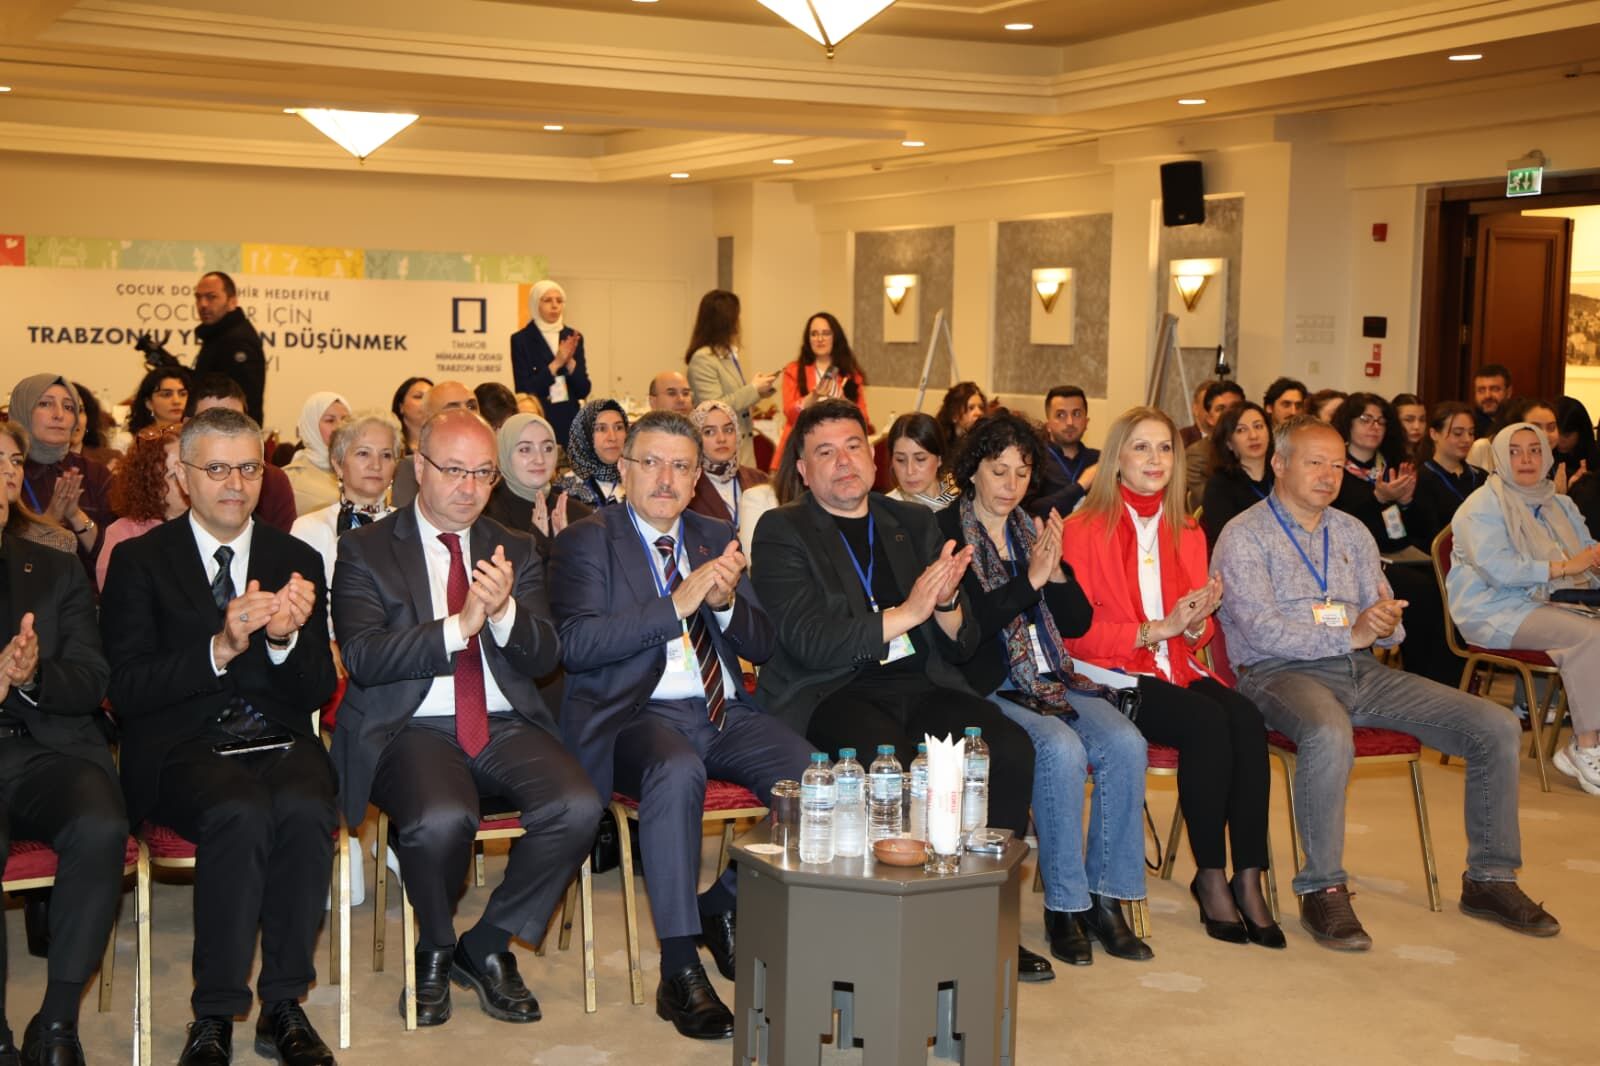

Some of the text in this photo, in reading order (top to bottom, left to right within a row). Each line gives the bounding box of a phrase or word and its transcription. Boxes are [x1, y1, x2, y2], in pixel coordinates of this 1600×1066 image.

[116, 283, 165, 297] ÇOCUK
[237, 287, 259, 299] HİR
[265, 288, 330, 302] HEDEFİYLE
[267, 303, 312, 326] İÇİN
[285, 328, 407, 353] DÜŞÜNMEK
